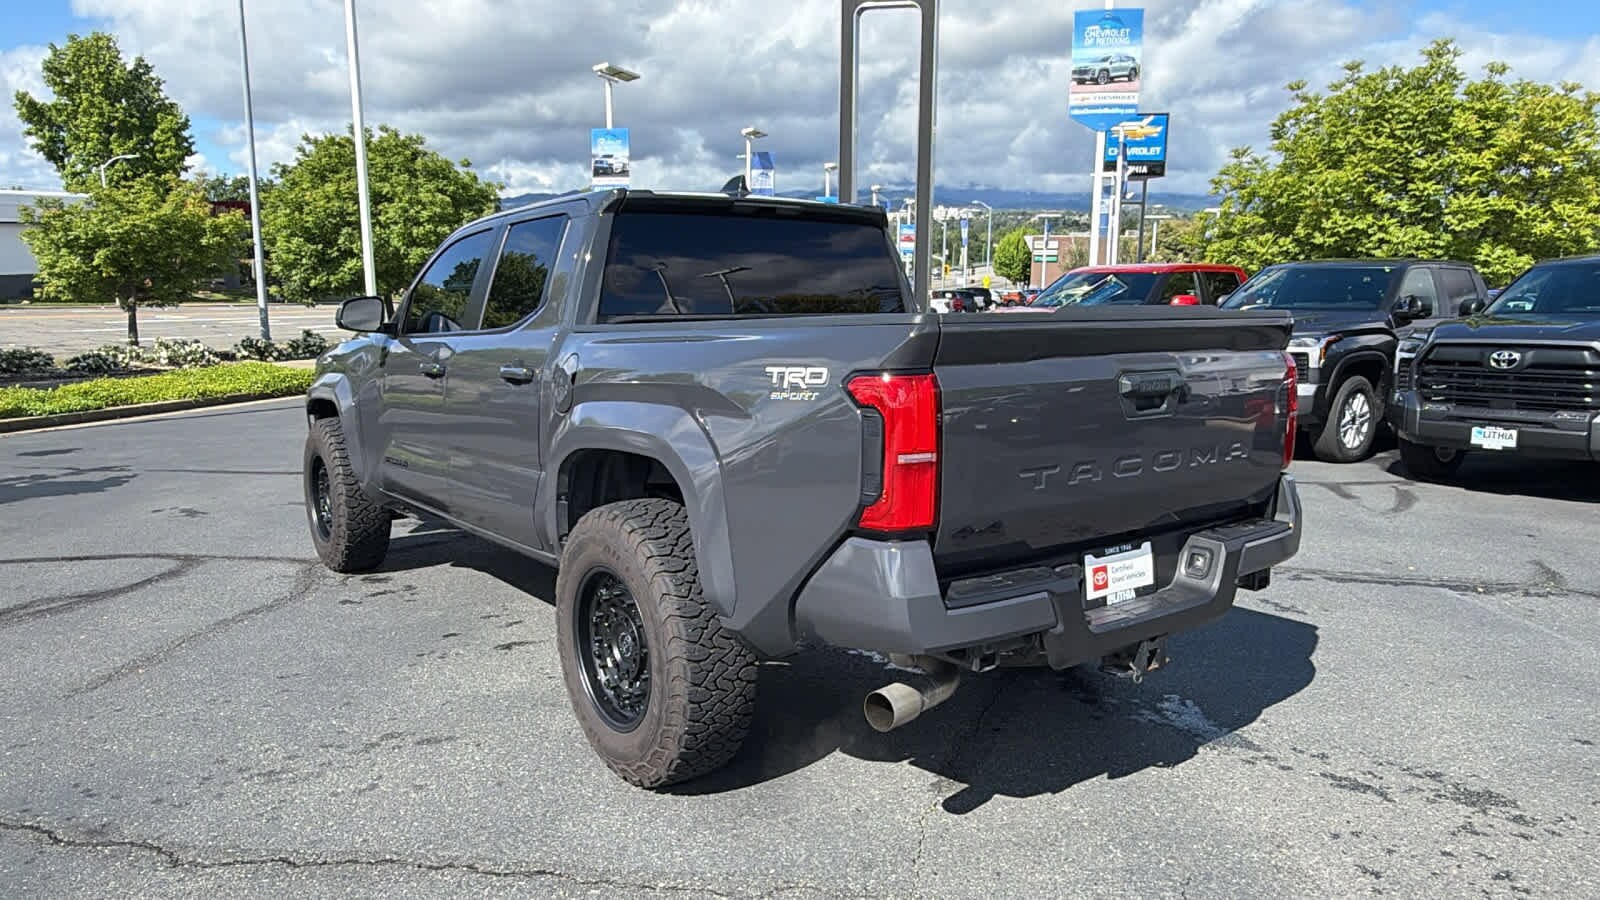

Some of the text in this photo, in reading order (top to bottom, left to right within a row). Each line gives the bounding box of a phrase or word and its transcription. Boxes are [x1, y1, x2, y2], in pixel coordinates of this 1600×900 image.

[1084, 27, 1131, 38] CHEVROLET
[765, 366, 828, 389] TRD
[770, 391, 819, 401] SPORT
[1482, 431, 1514, 441] LITHIA
[1017, 441, 1249, 491] TACOMA
